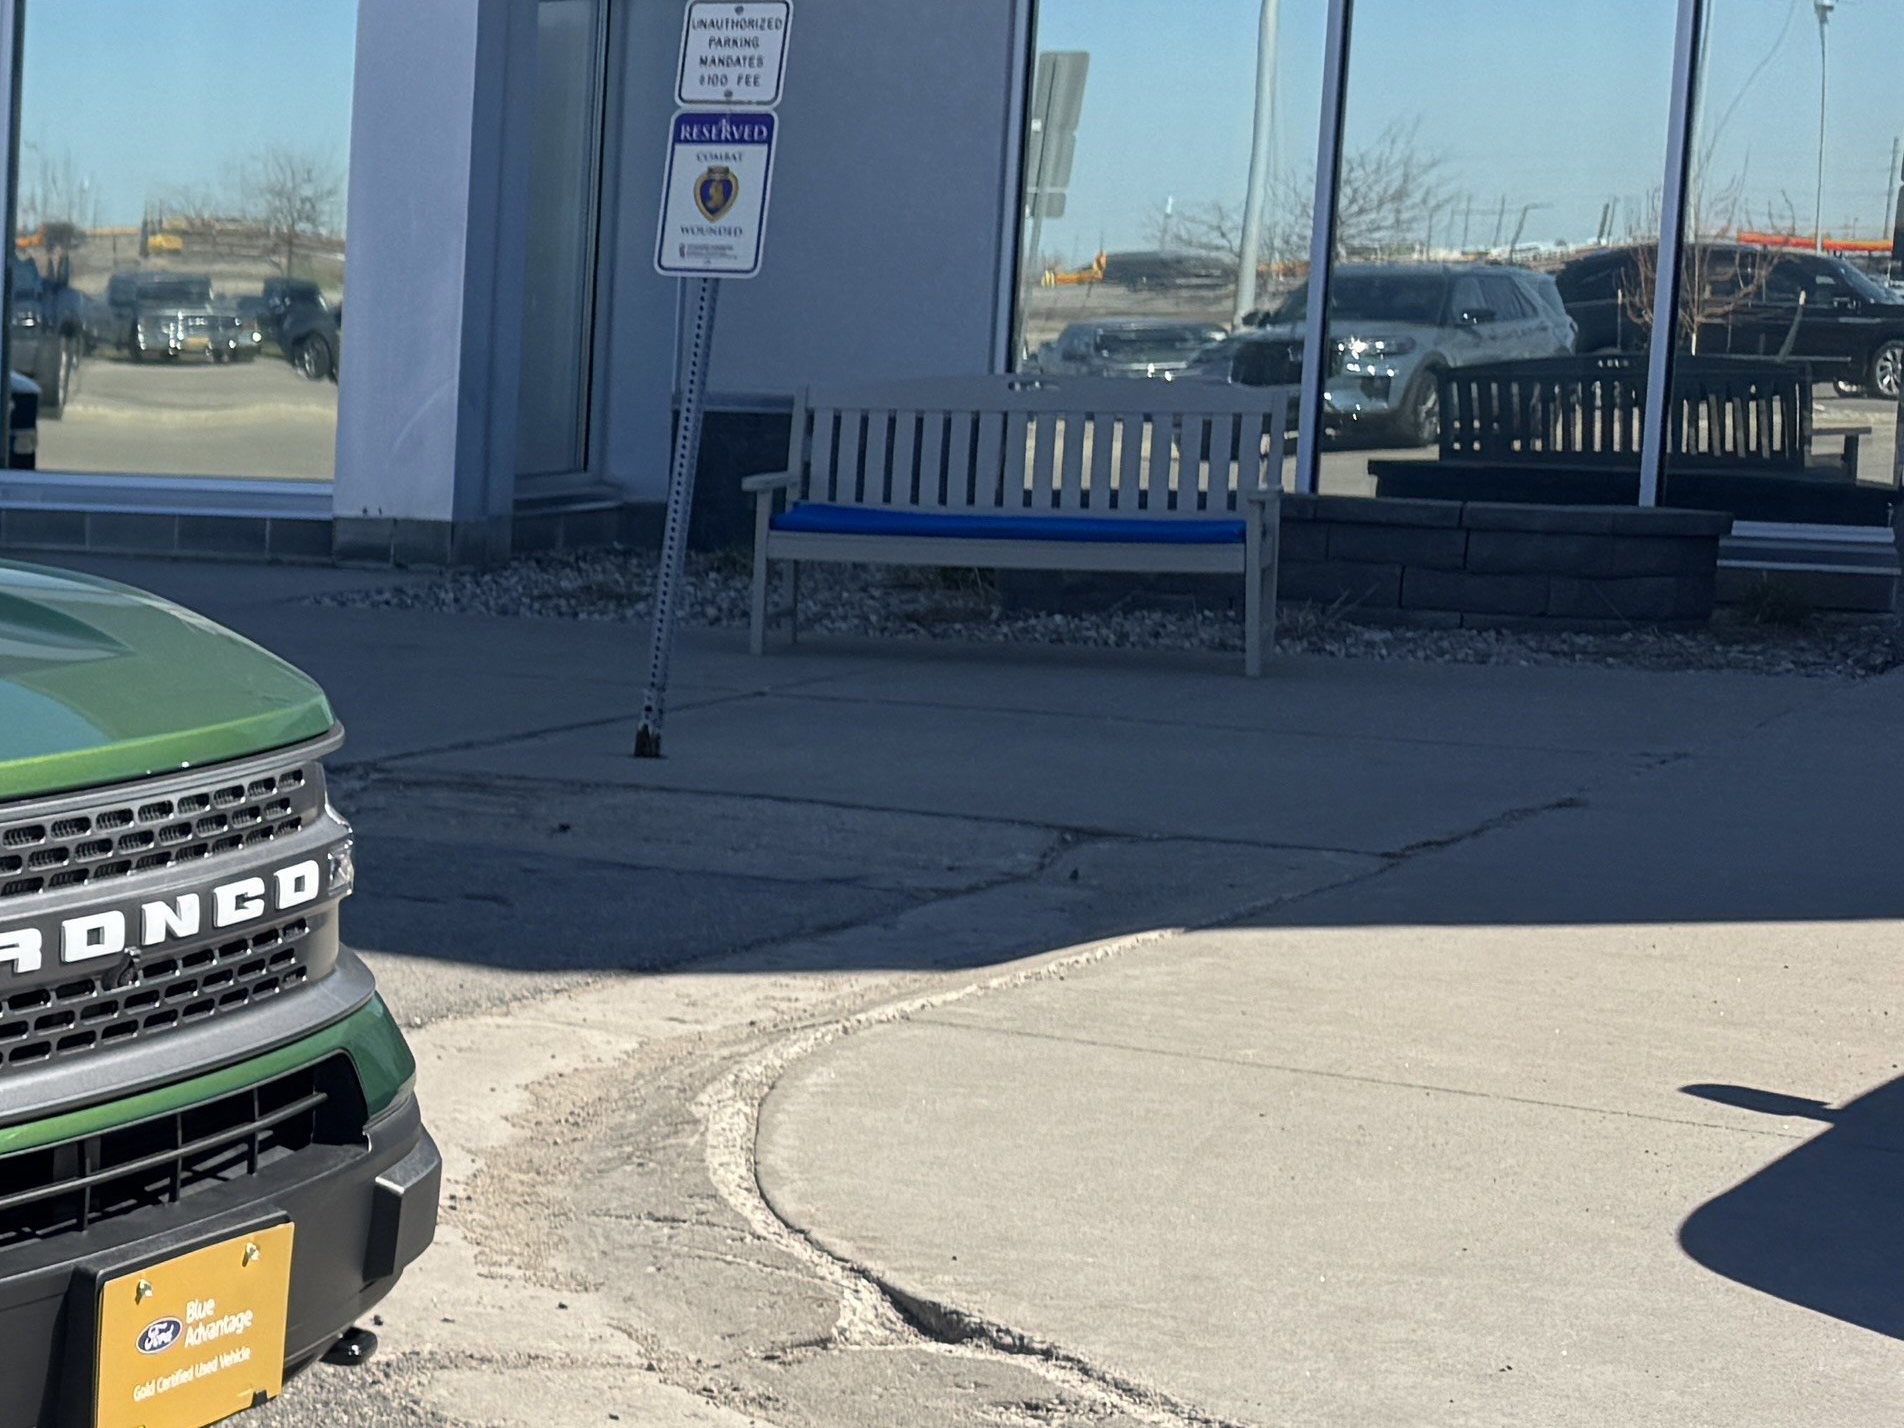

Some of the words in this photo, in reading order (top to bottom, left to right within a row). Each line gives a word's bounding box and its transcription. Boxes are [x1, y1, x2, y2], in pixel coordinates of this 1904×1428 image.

[691, 16, 783, 32] UNAUTHORIZED
[708, 35, 760, 50] PARKING
[699, 54, 764, 69] MANDATES
[736, 73, 761, 87] FEE
[680, 123, 768, 141] RESERVED
[696, 151, 744, 163] COMBAT
[680, 224, 744, 238] WOUNDED
[186, 1299, 216, 1324] Blue
[144, 1322, 175, 1351] Ford
[184, 1309, 254, 1349] Advantage
[133, 1379, 156, 1403] Gold
[156, 1365, 194, 1394] Certified
[194, 1355, 219, 1378] Used
[219, 1345, 252, 1369] Vehicle
